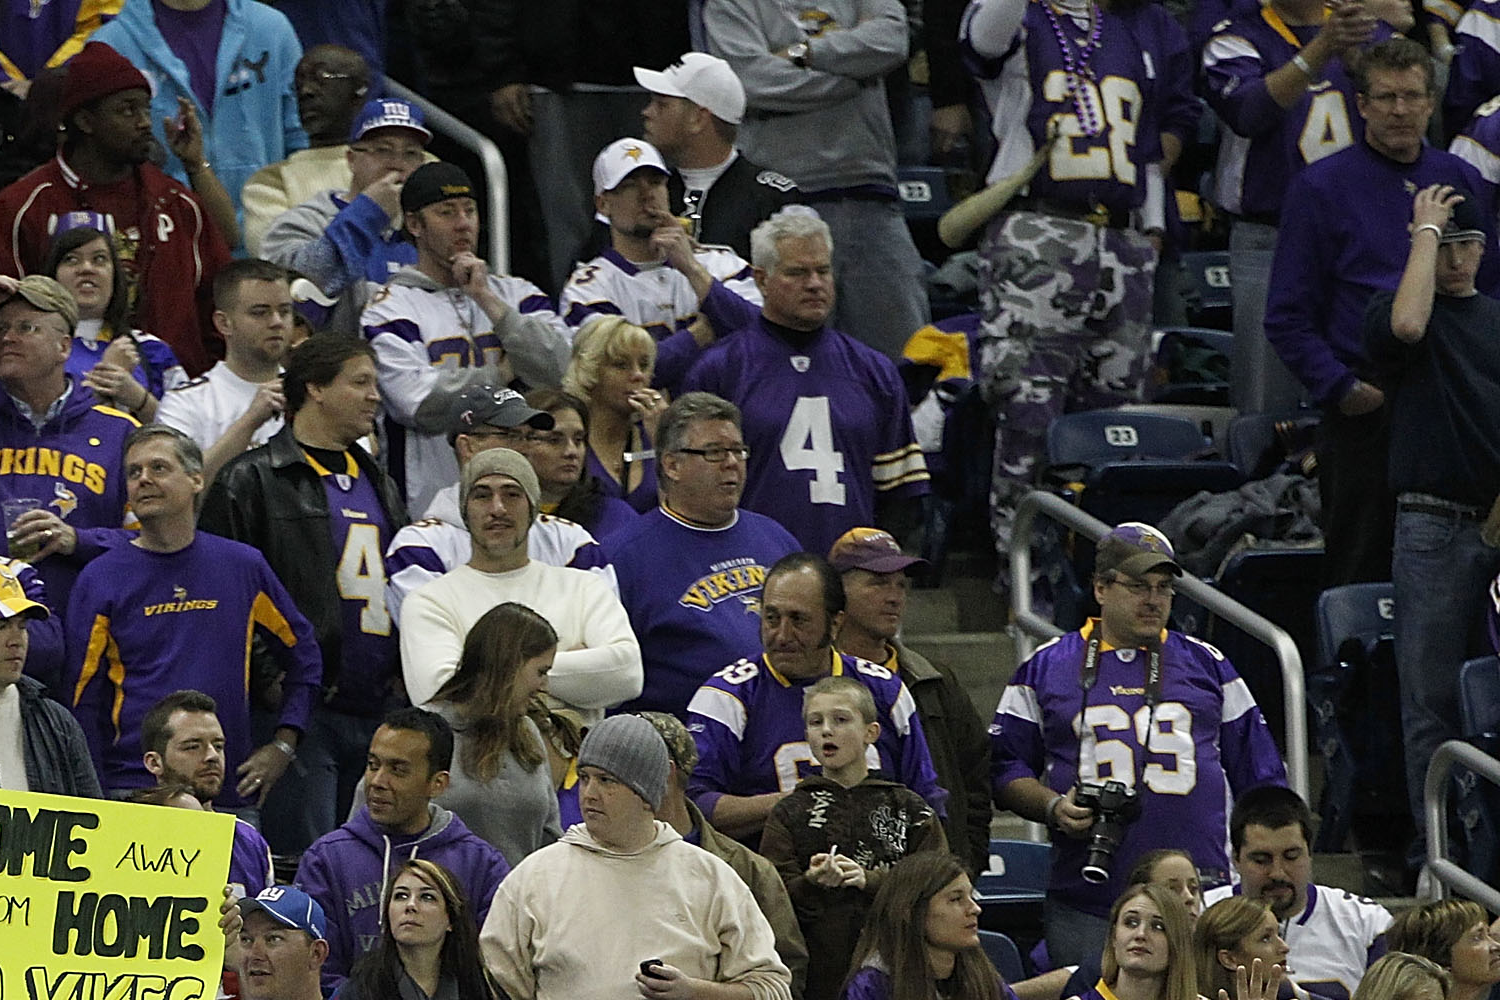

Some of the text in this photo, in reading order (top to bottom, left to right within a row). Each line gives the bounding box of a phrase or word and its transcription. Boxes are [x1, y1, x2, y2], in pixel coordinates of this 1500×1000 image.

[780, 397, 846, 506] 4
[143, 599, 220, 617] VIKINGS
[338, 522, 395, 635] 4
[1073, 704, 1197, 796] 69
[116, 841, 201, 877] AWAY
[52, 891, 209, 961] HOME
